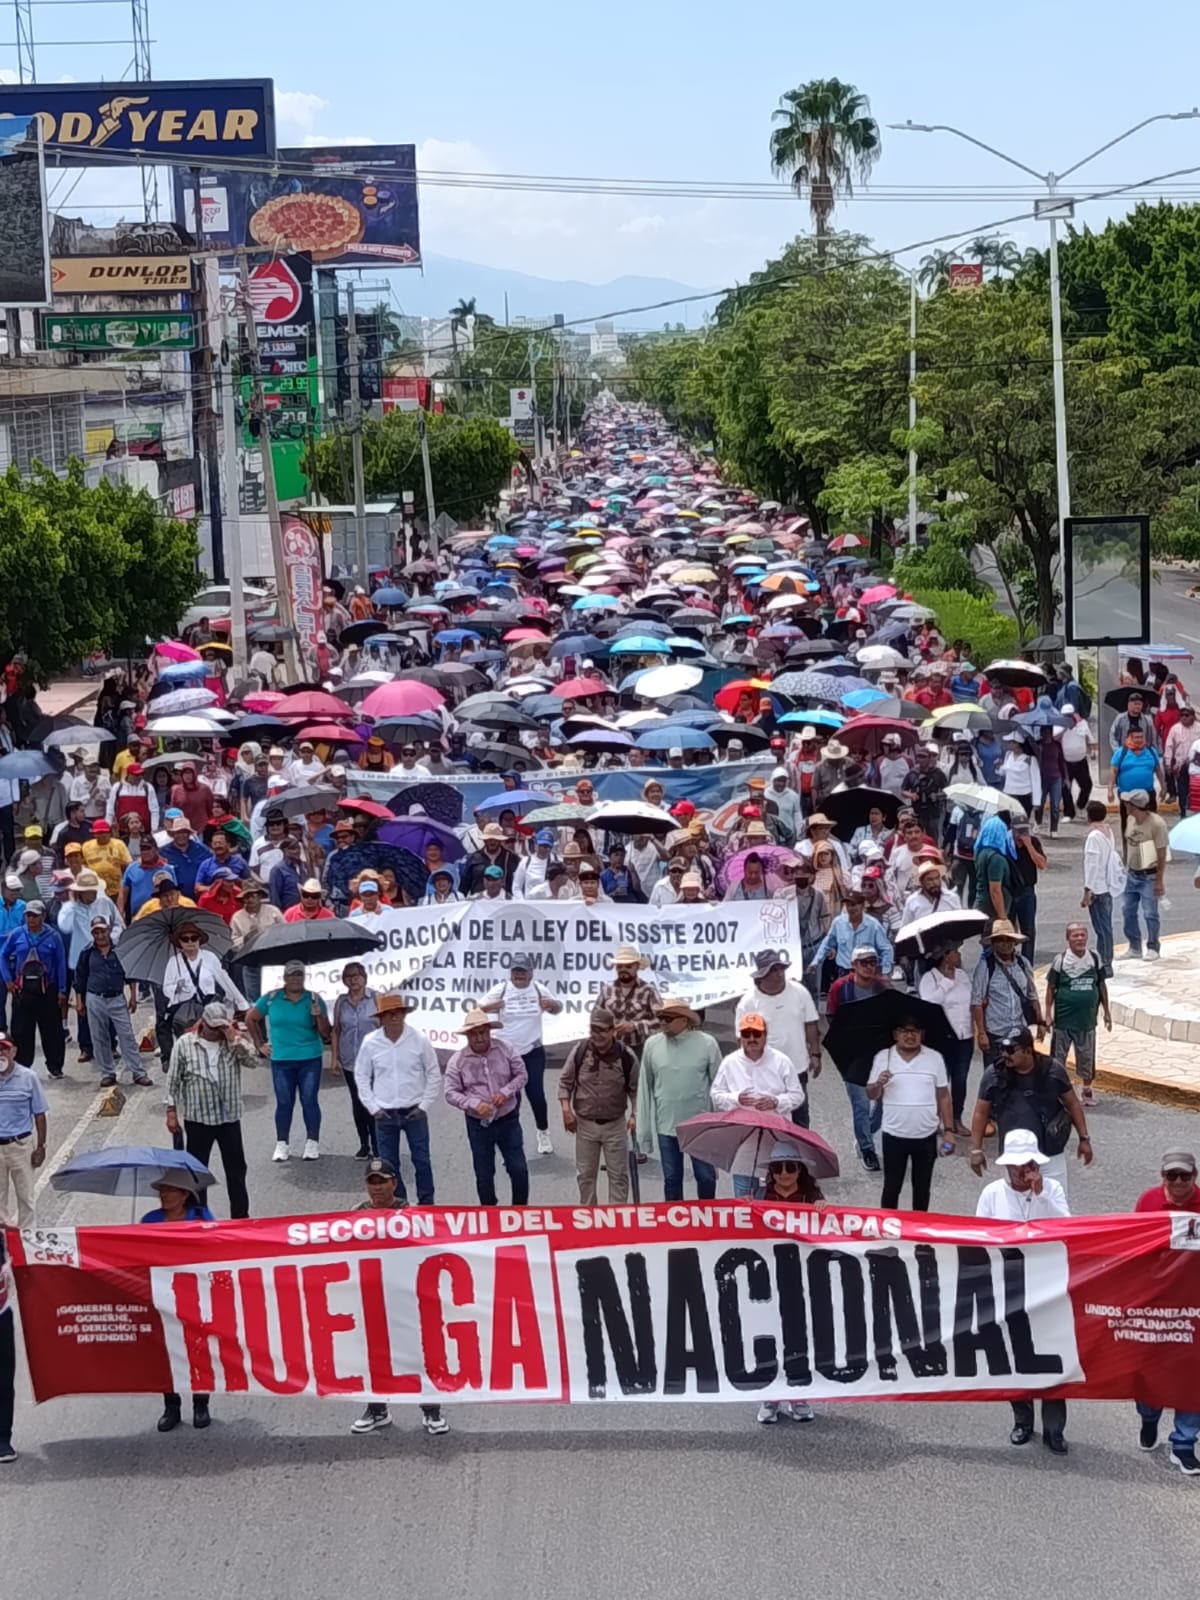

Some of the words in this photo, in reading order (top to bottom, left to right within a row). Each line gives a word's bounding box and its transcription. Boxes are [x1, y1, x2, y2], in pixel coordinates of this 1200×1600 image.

[129, 109, 258, 142] YEAR
[89, 265, 187, 278] DUNLOP
[143, 276, 187, 285] TIRES
[374, 918, 461, 952] OGACIÓN
[469, 919, 494, 941] DE
[501, 919, 525, 942] LA
[532, 919, 569, 942] LEY
[575, 920, 612, 942] DEL
[618, 921, 687, 944] ISSSTE
[693, 921, 739, 944] 2007
[432, 951, 457, 969] LA
[463, 950, 556, 970] REFOMA
[563, 950, 672, 971] EDUCVA
[677, 949, 790, 971] PEÑA-AO
[452, 974, 508, 993] MÍNI
[556, 980, 582, 995] NO
[404, 995, 478, 1014] DIATO
[287, 1209, 434, 1245] SECCIÓN
[443, 1211, 489, 1236] VII
[500, 1210, 563, 1233] DEL
[572, 1206, 753, 1231] SNTE-CNTE
[763, 1209, 902, 1240] CHIAPAS
[58, 1324, 80, 1335] LOS
[82, 1323, 138, 1332] DERECHOS
[172, 1245, 549, 1397] HUELGA
[576, 1243, 1063, 1398] NACIONAL
